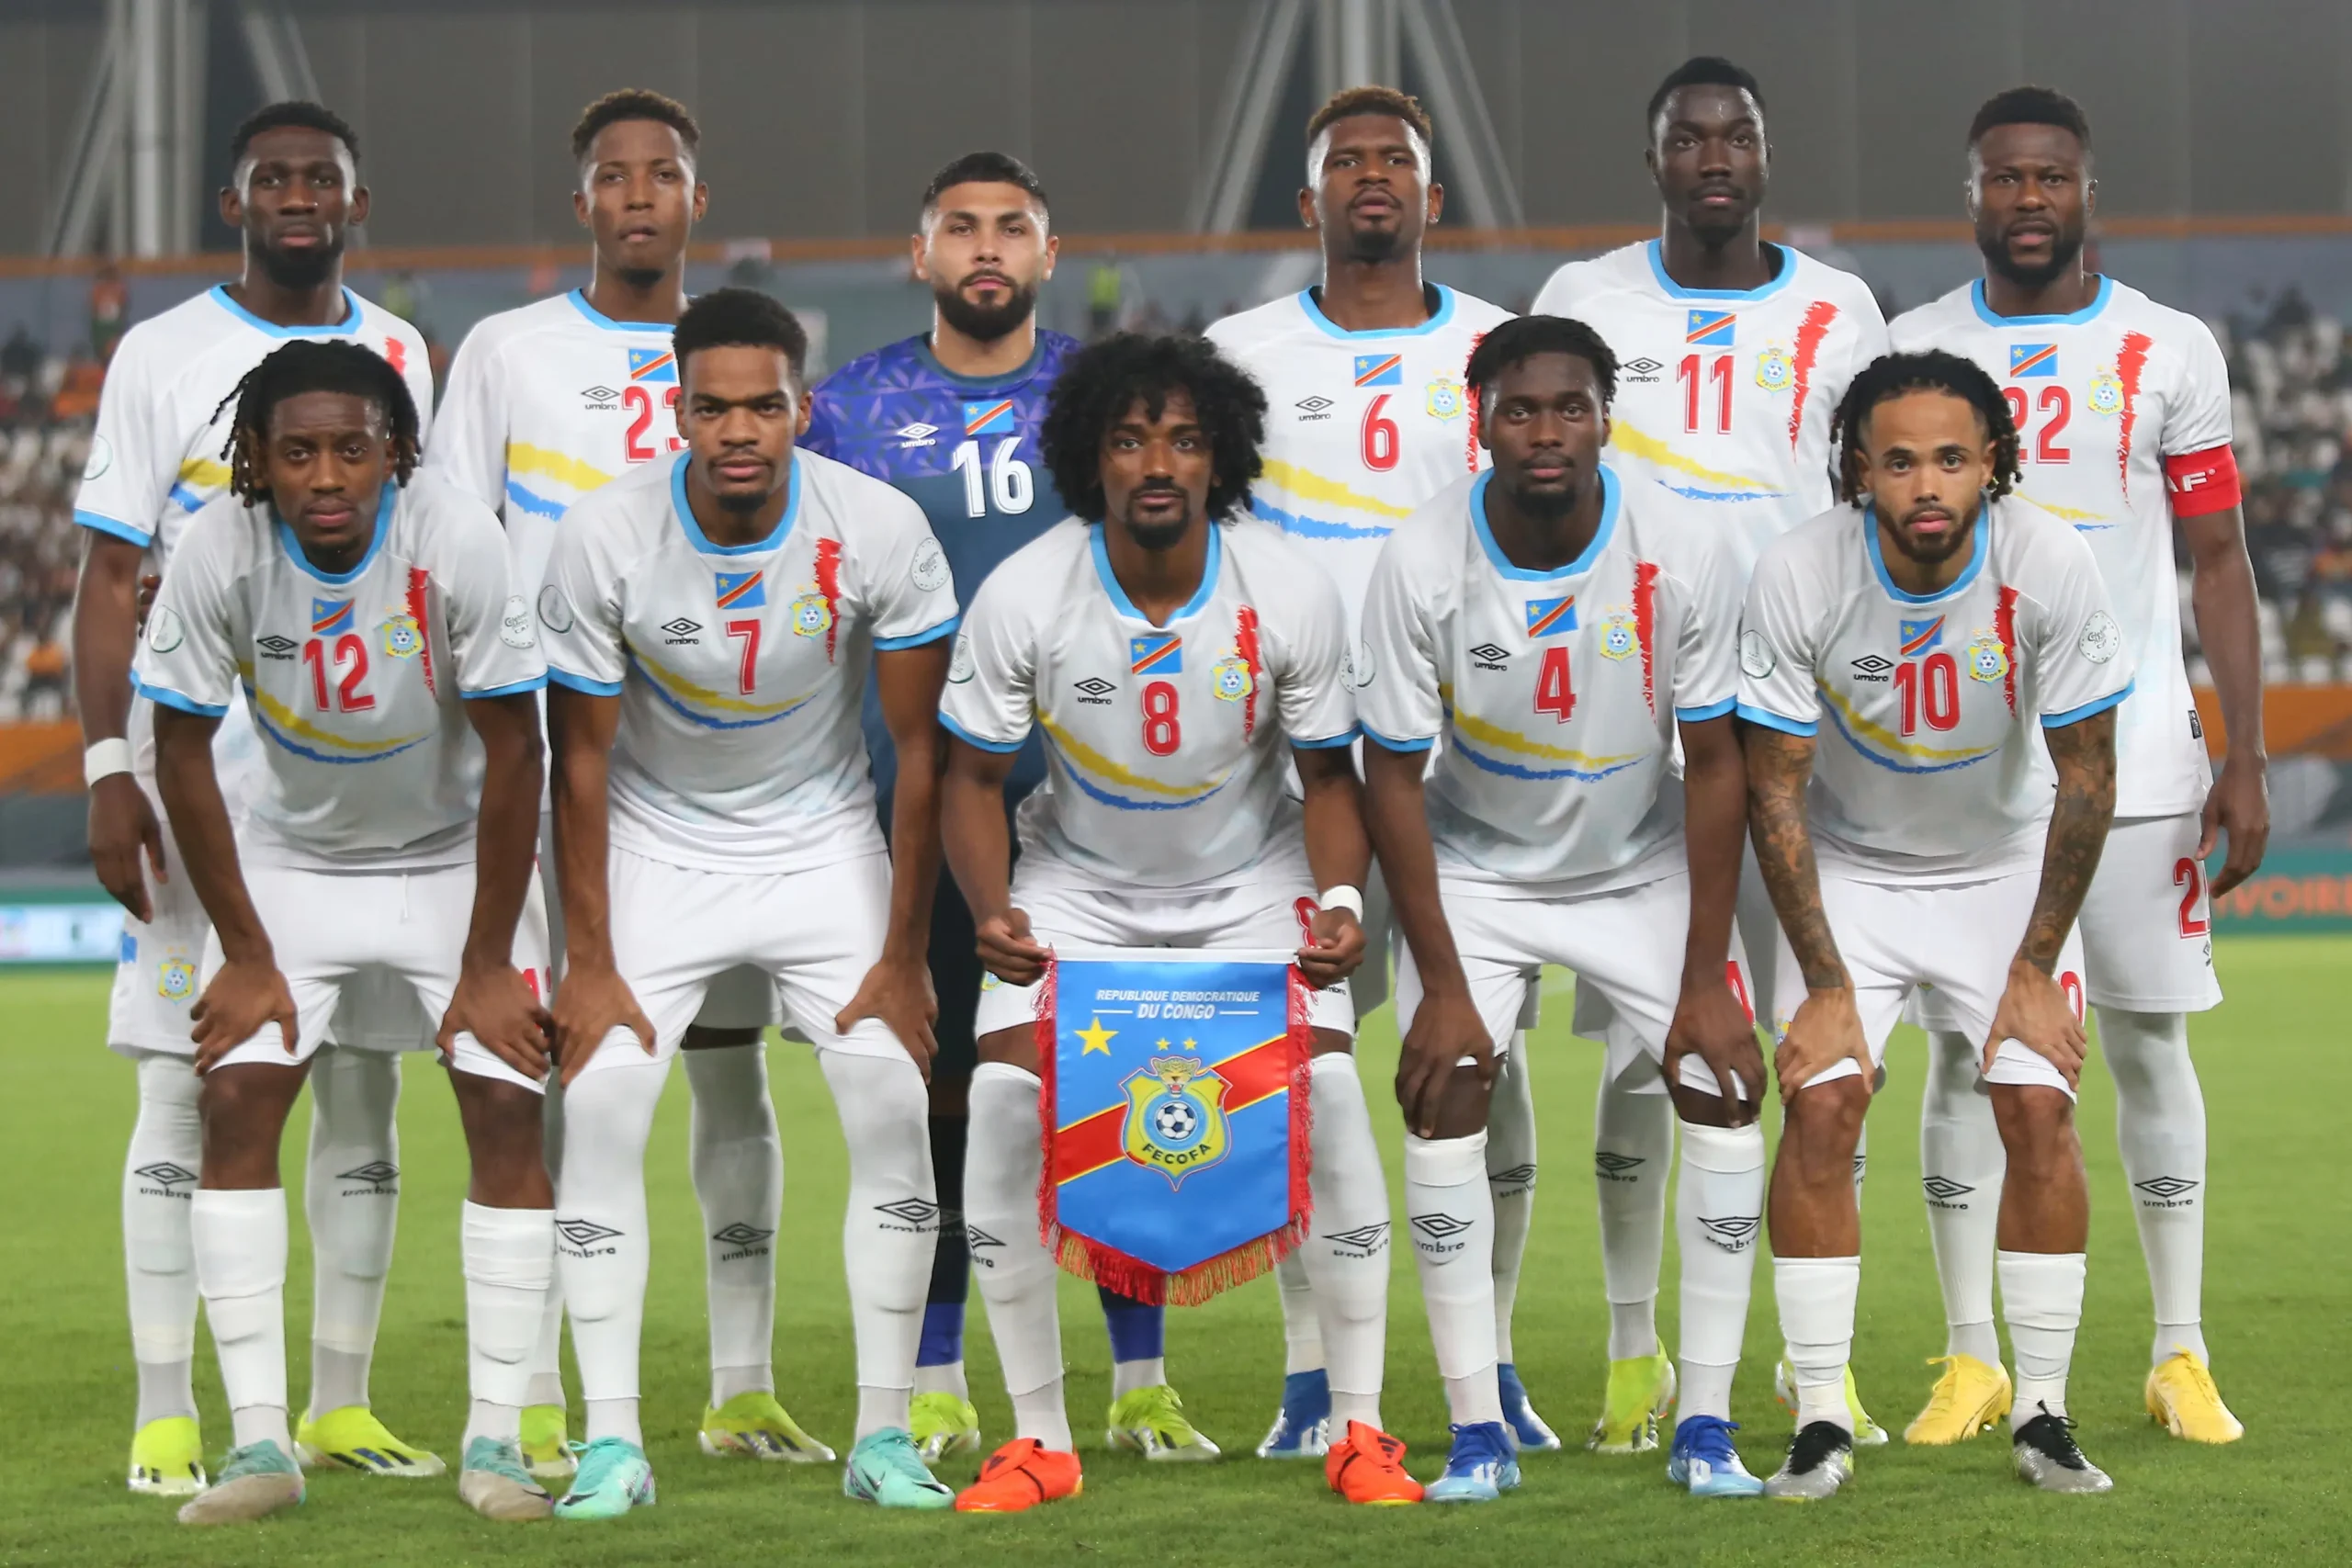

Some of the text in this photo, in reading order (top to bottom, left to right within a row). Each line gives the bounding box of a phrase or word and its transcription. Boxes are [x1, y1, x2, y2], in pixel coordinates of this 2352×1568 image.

[1626, 375, 1660, 383] umbro
[1676, 353, 1736, 435] 11
[584, 401, 618, 411] umbro
[1298, 412, 1331, 422] umbro
[1360, 393, 1400, 473] 6
[901, 437, 936, 448] umbro
[953, 436, 1035, 518] 16
[664, 637, 700, 646] umbro
[260, 650, 296, 660] umbro
[725, 618, 762, 695] 7
[1474, 661, 1508, 671] umbro
[302, 634, 376, 714] 12
[1853, 672, 1890, 682] umbro
[1533, 647, 1577, 725] 4
[1077, 695, 1113, 705] umbro
[1893, 652, 1961, 738] 10
[1140, 681, 1182, 758] 8
[1095, 988, 1260, 1002] REPUBLIQUE DEMOCRATIQUE
[1326, 985, 1347, 996] mbro
[1136, 1003, 1216, 1020] DU CONGO
[1141, 1143, 1212, 1165] FECOFA
[140, 1187, 192, 1200] umbro
[2143, 1198, 2194, 1208] umbro
[559, 1245, 616, 1258] umbro
[721, 1247, 769, 1262] umbro
